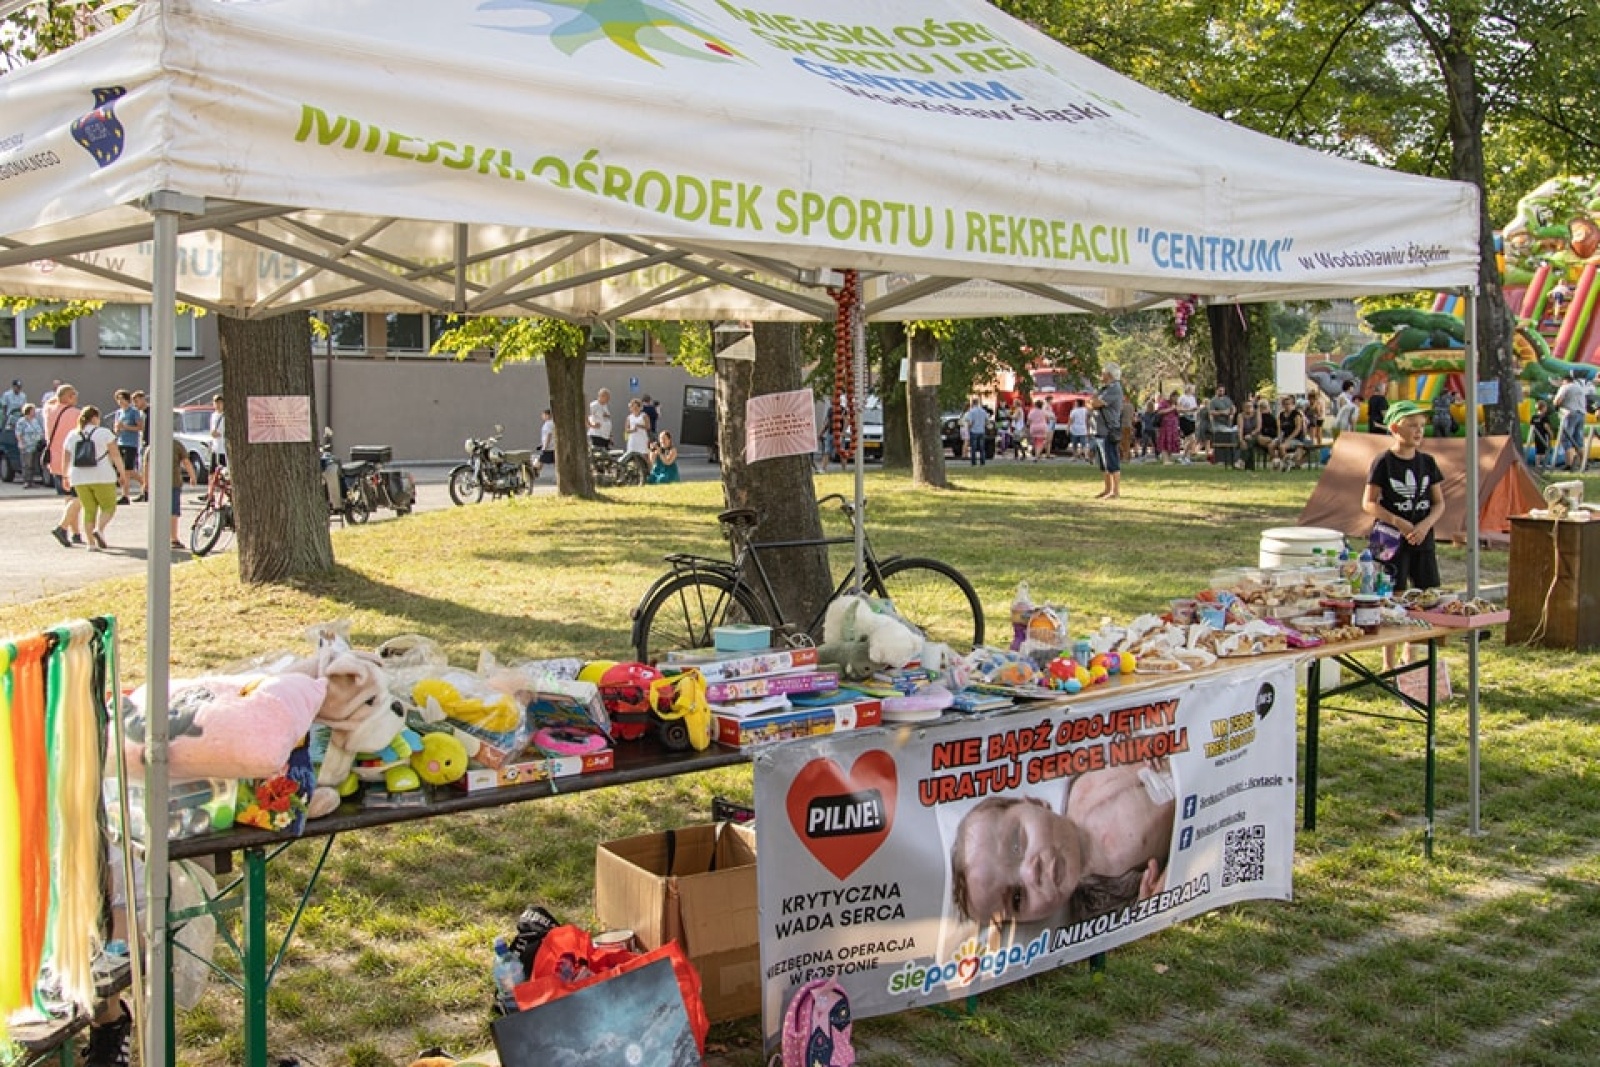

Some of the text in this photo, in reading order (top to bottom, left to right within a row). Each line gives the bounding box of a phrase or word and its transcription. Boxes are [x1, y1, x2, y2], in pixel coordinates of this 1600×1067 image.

[793, 57, 1025, 101] CENTRUM
[775, 188, 933, 248] SPORTU
[945, 208, 956, 250] I
[965, 211, 1130, 265] REKREACJI
[1298, 256, 1316, 270] w
[932, 737, 982, 771] NIE
[986, 718, 1053, 762] BĄDŹ
[1055, 698, 1180, 746] OBOJĘTNY
[918, 761, 1022, 807] URATUJ
[1026, 743, 1106, 784] SERCE
[1109, 727, 1190, 767] NIKOLI
[807, 799, 881, 833] PILNE!
[782, 881, 902, 916] KRYTYCZNA
[775, 903, 906, 940] WADA SERCA
[837, 937, 916, 961] OPERACJA
[789, 971, 803, 986] W
